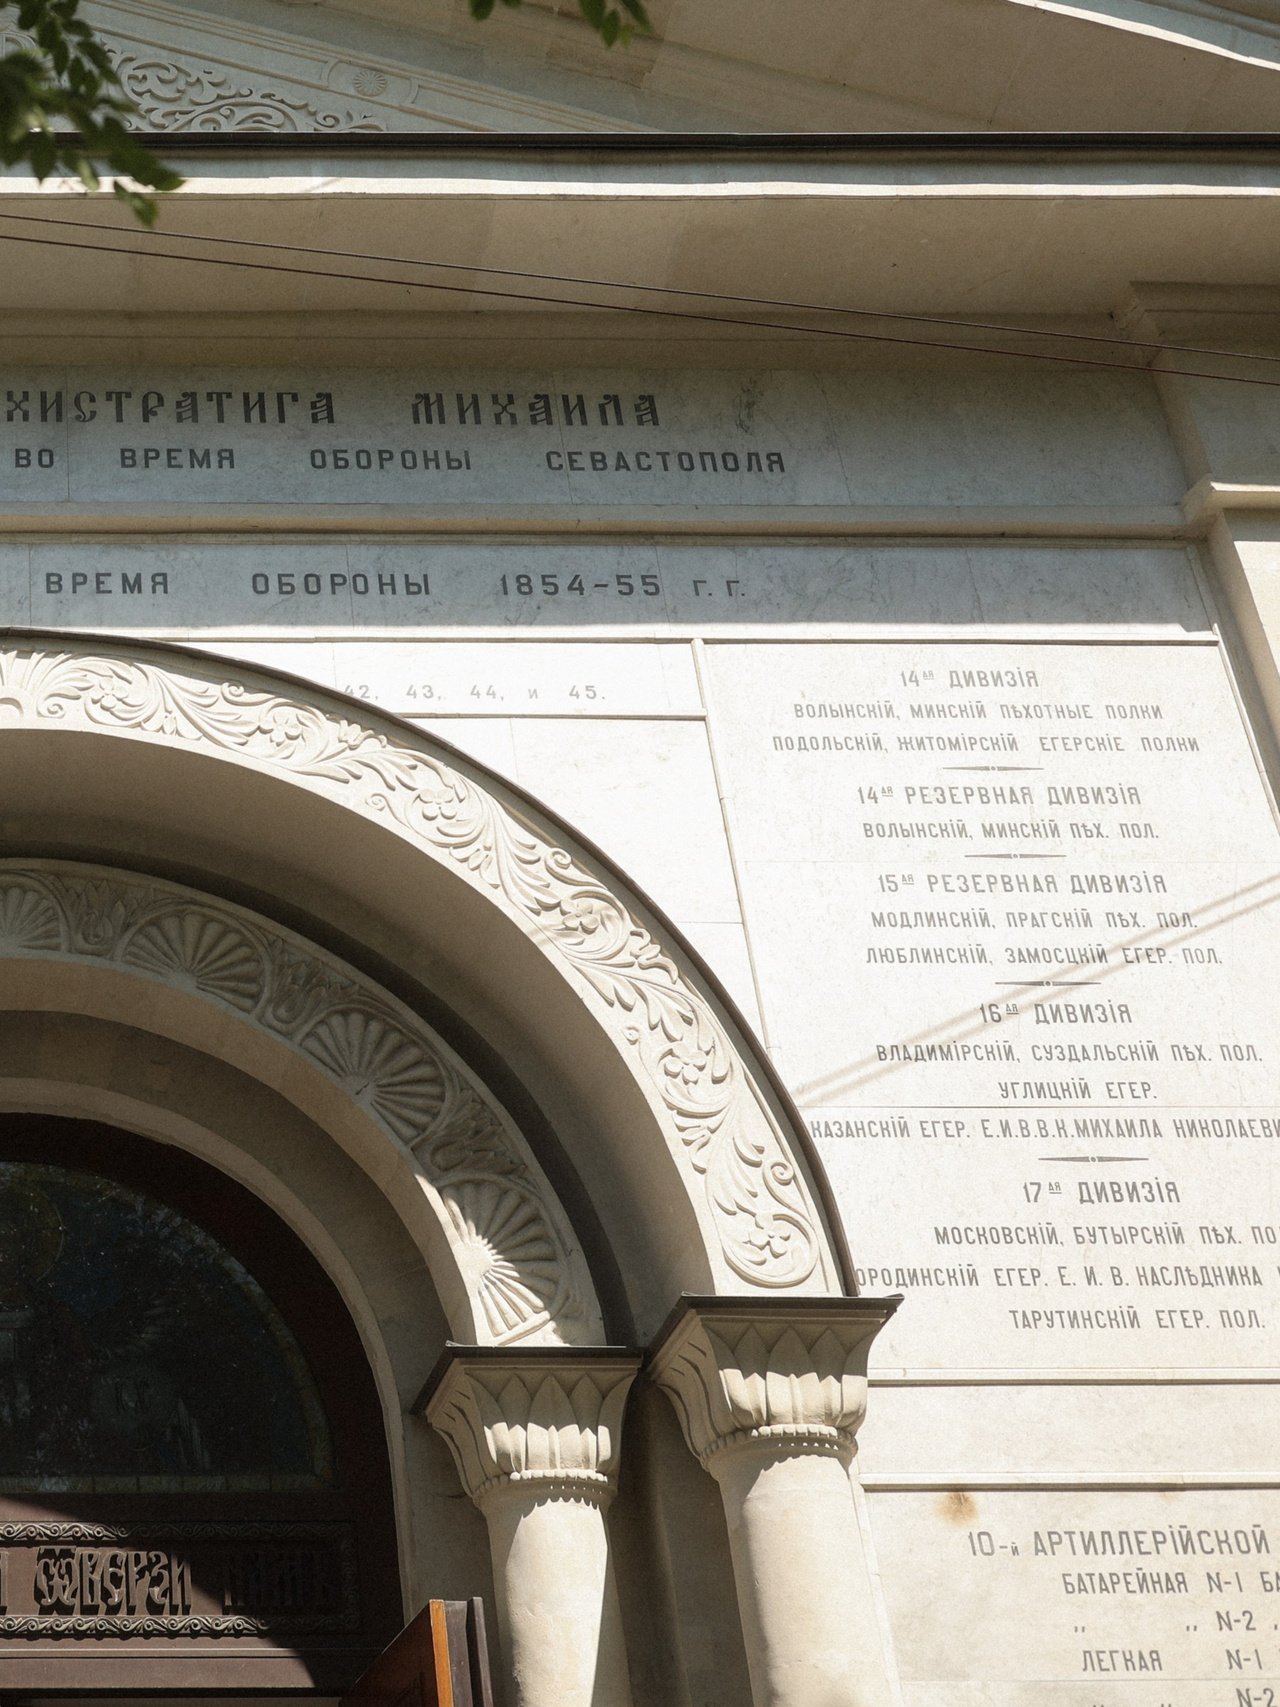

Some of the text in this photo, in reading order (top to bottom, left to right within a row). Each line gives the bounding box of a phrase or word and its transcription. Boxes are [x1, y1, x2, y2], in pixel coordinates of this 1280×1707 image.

[15, 448, 54, 468] ВО
[121, 448, 235, 469] ВРЕМЯ
[310, 449, 471, 470] ОБОРОНЫ
[546, 451, 785, 473] СЕВАСТОПОЛЯ
[46, 573, 168, 594] ВРЕМЯ
[252, 573, 430, 595] ОБОРОНЫ
[500, 574, 660, 596] 1854-55
[406, 685, 441, 700] 43,
[470, 685, 504, 701] 44,
[569, 685, 605, 699] 45.
[1105, 705, 1163, 719] ПОЛКИ
[1141, 737, 1199, 751] ПОЛКИ
[905, 787, 1033, 804] РЕЗЕРВНАЯ
[1119, 823, 1158, 838] ПОЛ.
[927, 875, 1058, 893] РЕЗЕРВНАЯ
[1157, 912, 1197, 929] ПОЛ.
[1120, 946, 1172, 964] ЕГЕР.
[1182, 948, 1222, 964] ПОЛ.
[1220, 1044, 1262, 1061] ПОЛ.
[1106, 1082, 1157, 1099] ЕГЕР.
[920, 1121, 970, 1138] ЕГЕР.
[994, 1268, 1048, 1286] ЕГЕР.
[1155, 1310, 1209, 1328] ЕГЕР.
[1219, 1310, 1265, 1328] ПОЛ.
[1062, 1568, 1188, 1594] БАТАРЕЙНАЯ
[1083, 1650, 1162, 1671] ЛЕГКАЯ
